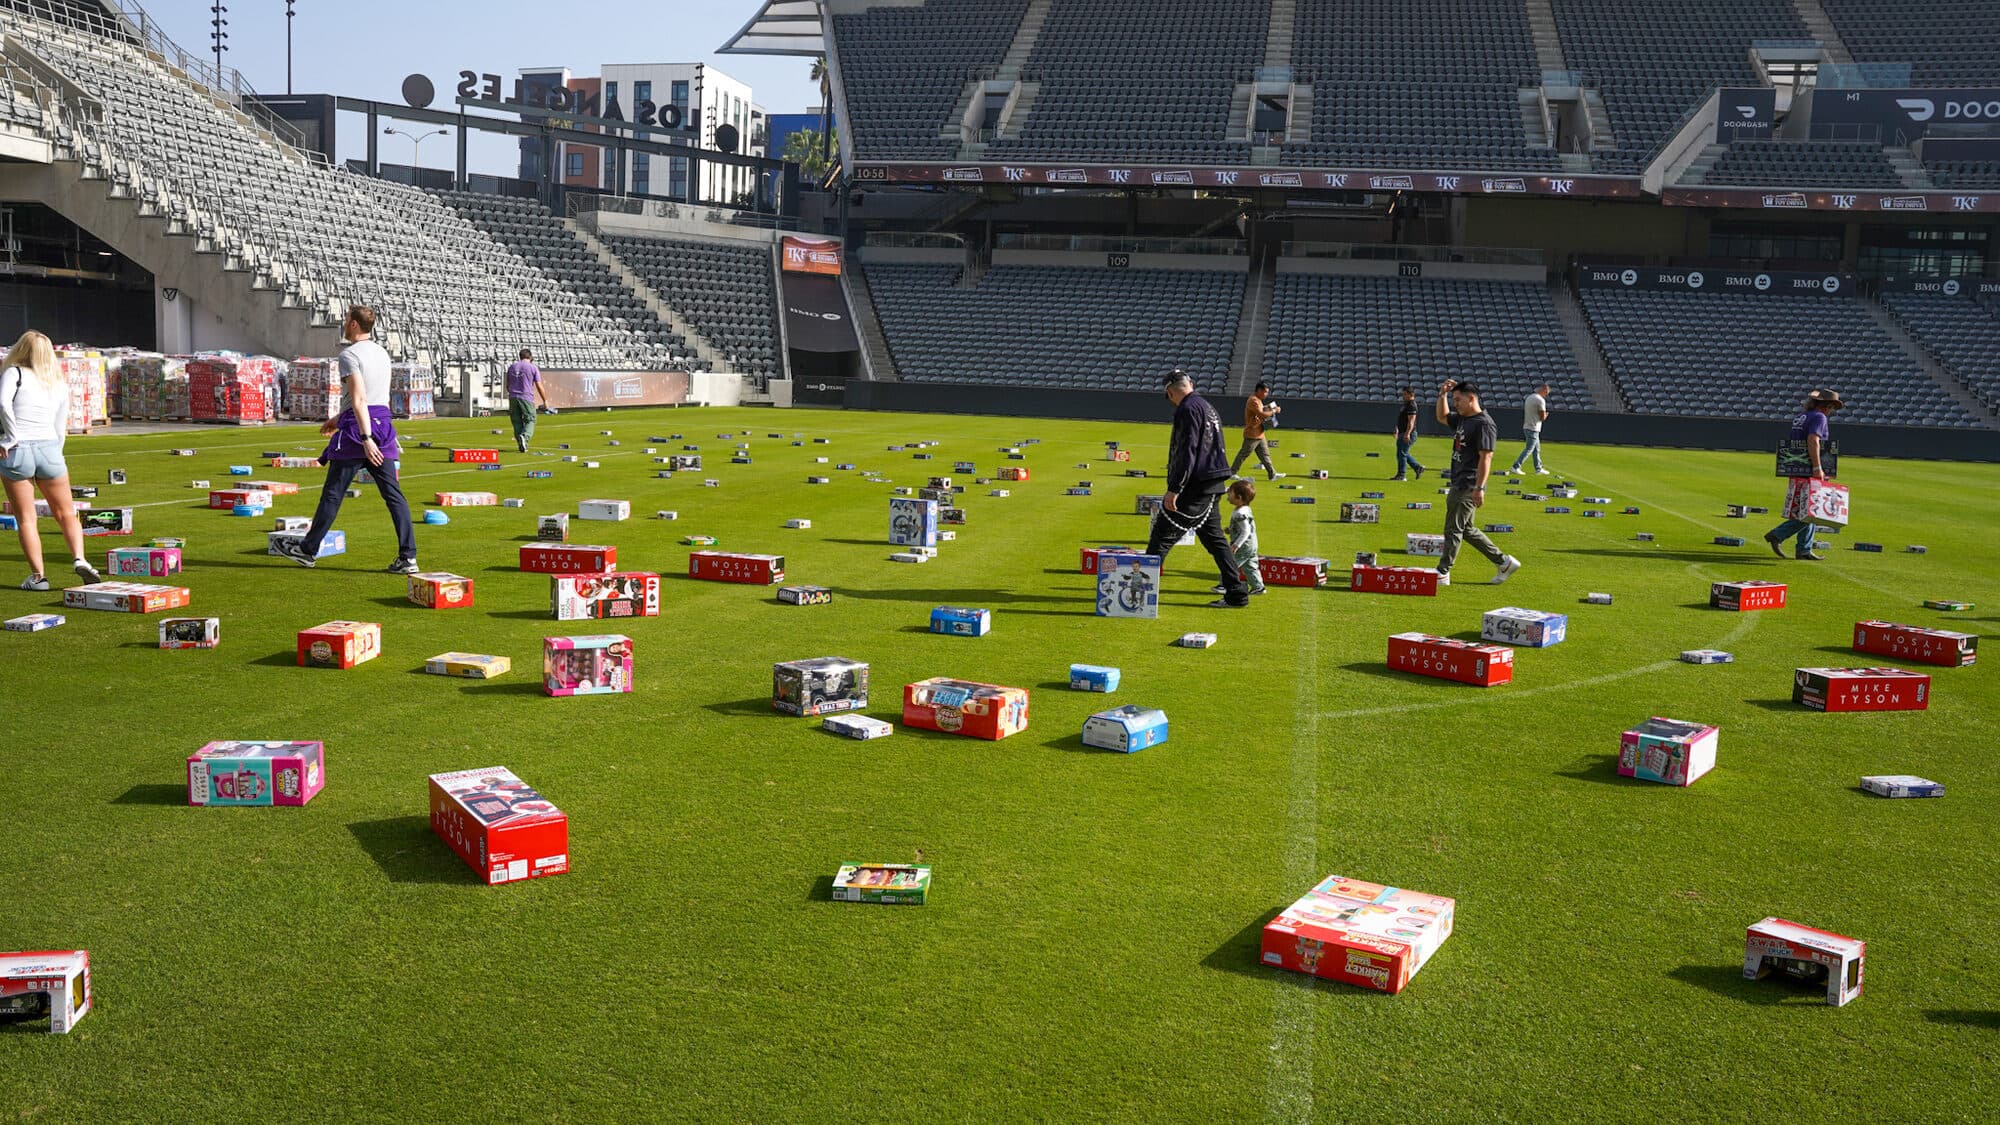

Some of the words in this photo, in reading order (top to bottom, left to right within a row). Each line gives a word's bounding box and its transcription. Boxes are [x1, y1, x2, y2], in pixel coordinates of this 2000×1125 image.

[857, 168, 884, 179] 10:58
[1003, 166, 1026, 181] TKF
[1108, 169, 1131, 183] TKF
[1215, 171, 1239, 185] TKF
[1324, 173, 1348, 187] TKF
[1436, 176, 1460, 190] TKF
[1550, 179, 1574, 193] TKF
[1832, 194, 1857, 209] TKF
[1952, 196, 1979, 210] TKF
[1109, 255, 1127, 267] 109
[1401, 265, 1419, 276] 110
[1593, 272, 1619, 282] BMO
[1658, 274, 1685, 284] BMO
[1725, 276, 1752, 286] BMO
[1793, 279, 1820, 288] BMO
[1914, 282, 1940, 291] BMO
[1980, 284, 2000, 292] BM
[531, 560, 581, 569] TYSON
[712, 560, 759, 572] TYSON
[1260, 563, 1305, 575] TYSON
[720, 569, 751, 578] MIKE
[1268, 573, 1298, 581] MIKE
[1377, 574, 1427, 584] TYSON
[1384, 582, 1418, 590] MIKE
[1751, 590, 1770, 598] MIKE
[1746, 598, 1774, 607] TYSON
[1882, 633, 1943, 651] TYSON
[1410, 647, 1449, 661] MIKE
[1892, 644, 1932, 657] MIKE
[1400, 656, 1458, 673] TYSON
[1851, 684, 1892, 693] MIKE
[1840, 694, 1900, 705] TYSON
[441, 801, 464, 829] MIKE
[435, 812, 471, 855] TYSON
[1767, 947, 1792, 956] TRUCK
[1345, 962, 1389, 977] MARKET
